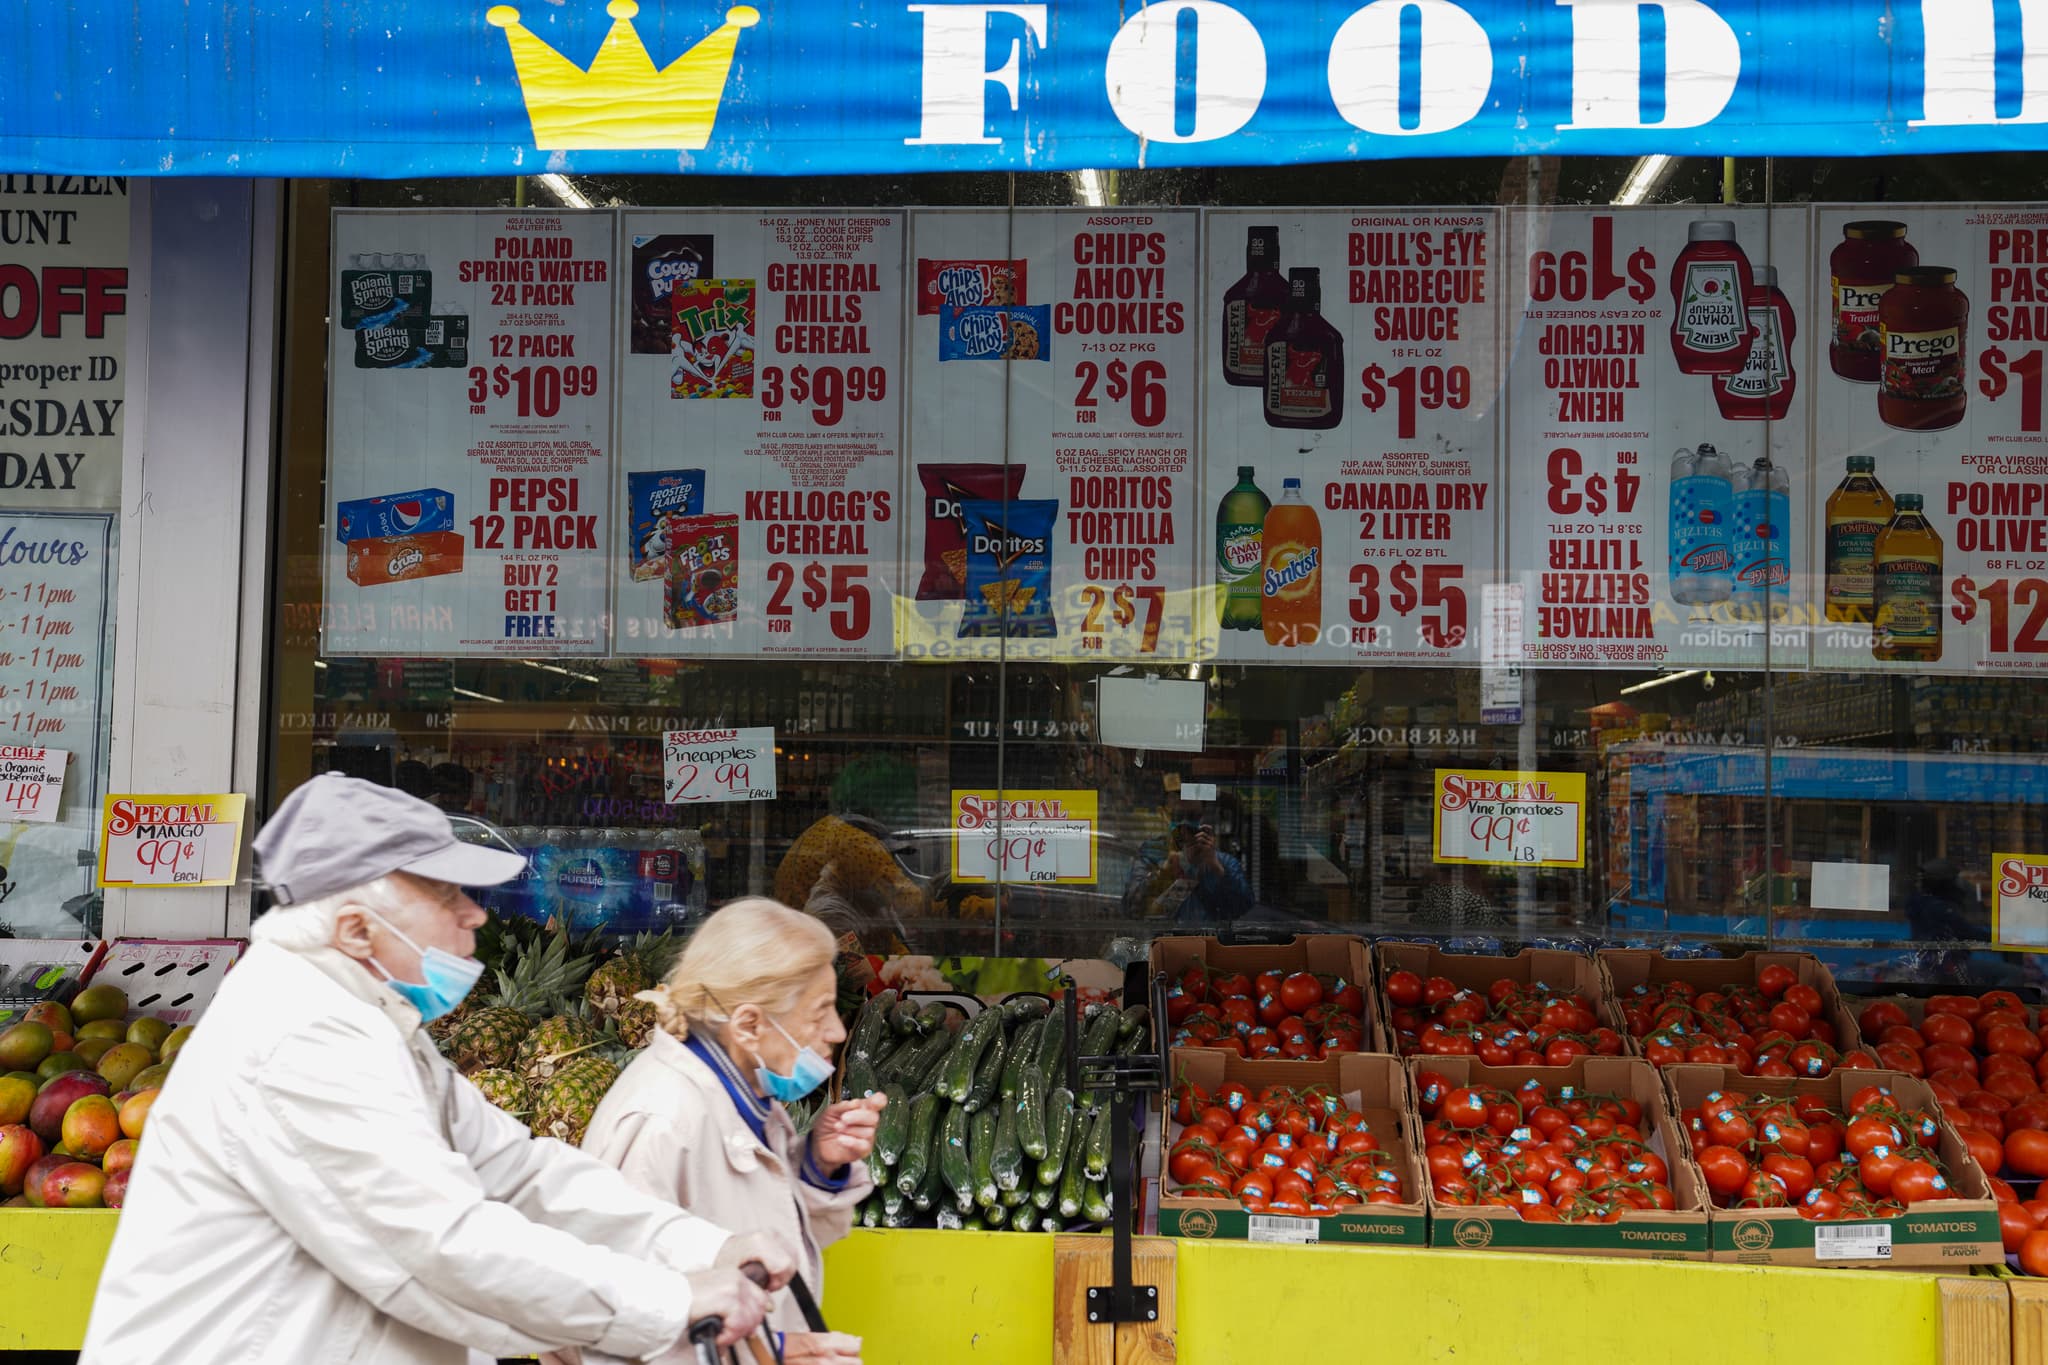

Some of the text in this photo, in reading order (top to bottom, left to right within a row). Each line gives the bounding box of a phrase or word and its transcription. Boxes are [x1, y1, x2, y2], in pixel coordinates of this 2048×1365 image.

[905, 0, 1741, 144] FOOD
[1087, 216, 1153, 225] ASSORTED
[1352, 217, 1484, 226] ORIGINAL OR KANSAS
[495, 237, 572, 258] POLAND
[1074, 233, 1165, 264] CHIPS
[1349, 232, 1486, 266] BULL'S-EYE
[459, 261, 606, 282] SPRING WATER
[767, 264, 880, 291] GENERAL
[1074, 268, 1163, 298] AHOY!
[351, 275, 391, 292] Poland
[491, 285, 574, 305] 24 PACK
[1349, 270, 1485, 303] BARBECUE
[0, 264, 128, 339] OFF
[353, 286, 393, 305] Spring
[679, 298, 750, 340] Trix
[785, 295, 861, 323] MILLS
[1055, 302, 1184, 334] COOKIES
[1688, 314, 1736, 325] TOMATO
[1690, 304, 1733, 314] KETCHUP
[960, 314, 1000, 341] Chips
[1375, 307, 1458, 341] SAUCE
[490, 335, 574, 357] 12 PACK
[776, 326, 870, 354] CEREAL
[1082, 343, 1155, 352] 7-13 OZ PKG
[1539, 325, 1644, 354] KETCHUP
[1694, 332, 1730, 344] HEINZ
[1890, 334, 1955, 357] Prego
[1392, 349, 1441, 357] 18 FL OZ
[0, 356, 117, 389] proper ID
[1075, 361, 1098, 406] 2
[1545, 358, 1639, 388] TOMATO
[469, 366, 487, 403] 3
[762, 366, 783, 408] 3
[470, 406, 485, 414] FOR
[764, 412, 781, 421] FOR
[1077, 411, 1096, 422] FOR
[1559, 392, 1624, 422] HEINZ
[1173, 456, 1186, 464] OR
[1617, 452, 1637, 464] FOR
[1962, 456, 2048, 465] EXTRA VIRGIN
[490, 478, 578, 512] PEPSI
[650, 484, 692, 501] FROSTED
[652, 494, 687, 509] FLAKES
[1070, 476, 1172, 508] DORITOS
[1325, 483, 1488, 510] CANADA DRY
[1614, 468, 1640, 512] 4
[745, 491, 891, 521] KELLOGG'S
[470, 516, 597, 549] 12 PACK
[1067, 512, 1174, 544] TORTILLA
[1360, 513, 1450, 540] 2 LITER
[1548, 524, 1642, 534] 33.8 FL OZ BTL
[1957, 518, 2048, 552] OLIVE
[767, 524, 868, 554] CEREAL
[975, 536, 1044, 552] Doritos
[388, 549, 423, 576] Crush
[1085, 548, 1155, 580] CHIPS
[1364, 548, 1447, 557] 67.6 FL OZ BTL
[1549, 540, 1642, 570] 1 LITER
[504, 565, 558, 586] BUY 2
[1264, 547, 1318, 596] Sunkist
[1987, 560, 2045, 569] 68 FL OZ
[767, 562, 794, 615] 2
[1349, 564, 1380, 622] 3
[1542, 573, 1649, 604] SELTZER
[505, 590, 555, 611] GET 1
[1081, 586, 1105, 632] 2
[505, 616, 554, 637] FREE
[768, 620, 791, 632] FOR
[1538, 607, 1654, 638] VINTAGE
[1083, 638, 1102, 648] FOR
[1352, 627, 1376, 643] FOR
[666, 747, 756, 763] Pineapples
[750, 788, 772, 798] EACH
[1440, 774, 1556, 811] SPECIAL
[108, 800, 217, 835] SPECIAL
[958, 795, 1068, 829] SPECIAL
[1468, 801, 1563, 816] Vine Tomatoes
[137, 824, 204, 839] MANGO
[1514, 847, 1534, 862] LB
[174, 872, 198, 882] EACH
[1030, 871, 1056, 880] EACH
[1341, 1224, 1404, 1234] TOMATOES
[1621, 1231, 1686, 1242] TOMATOES
[1735, 1235, 1772, 1243] SUNSET
[1907, 1222, 1977, 1233] TOMATOES
